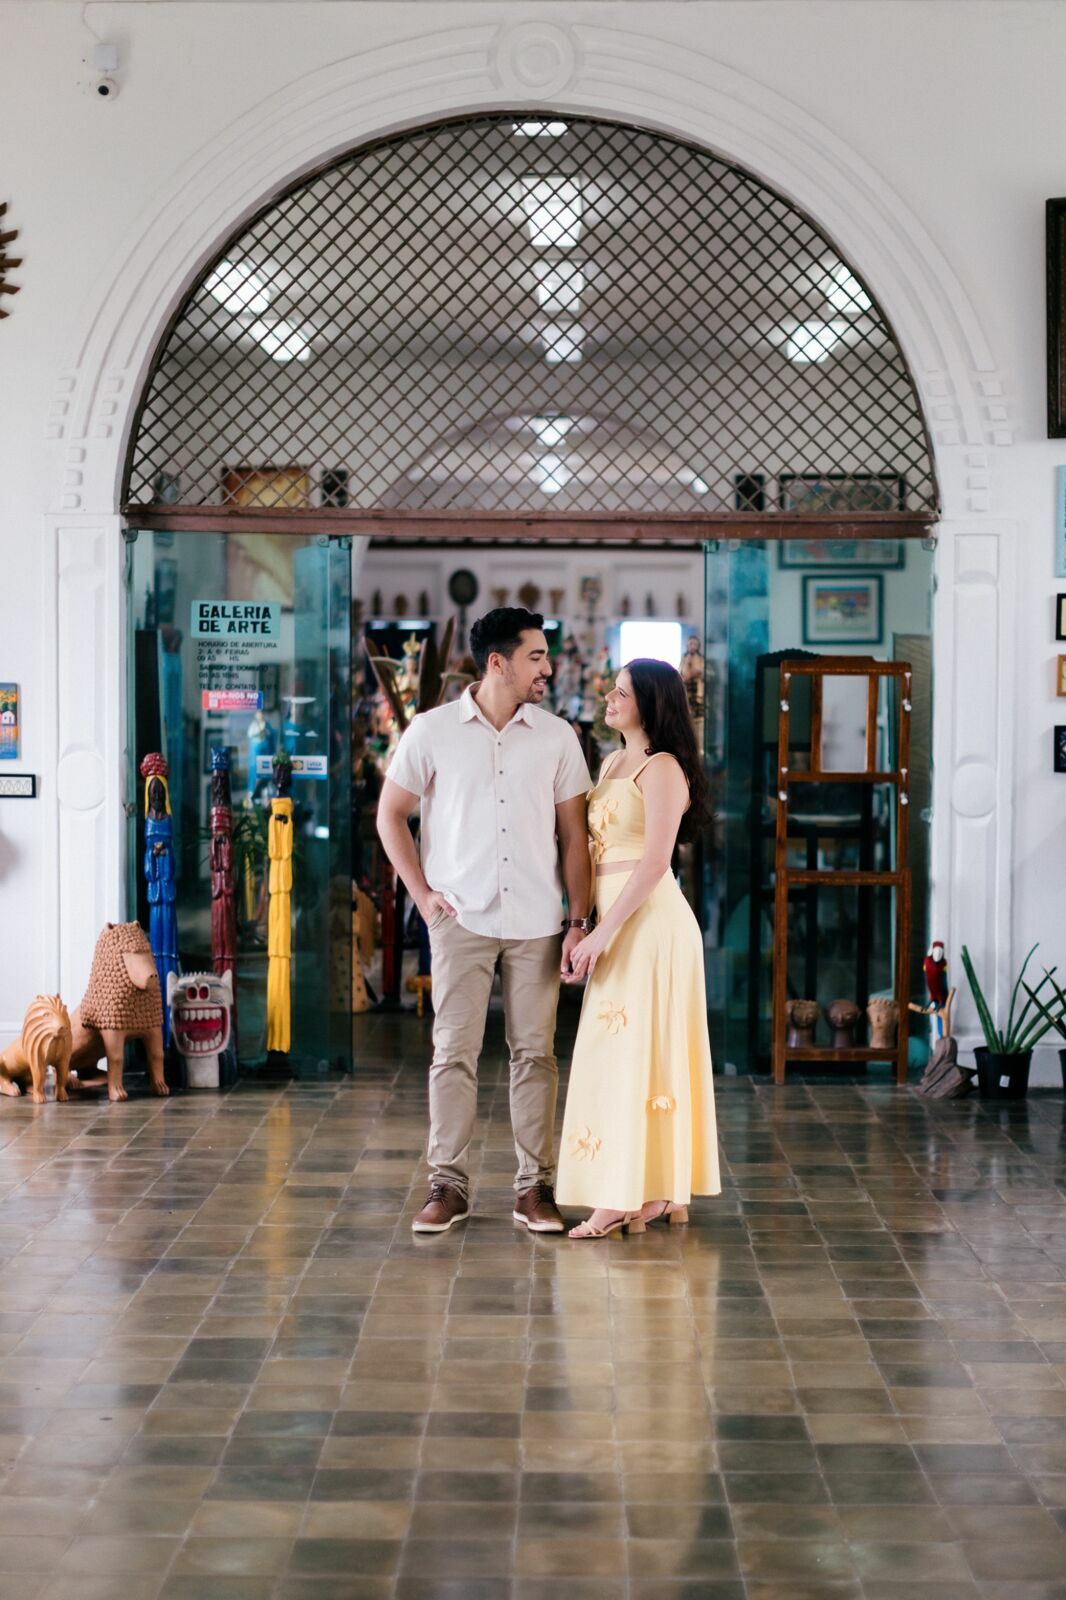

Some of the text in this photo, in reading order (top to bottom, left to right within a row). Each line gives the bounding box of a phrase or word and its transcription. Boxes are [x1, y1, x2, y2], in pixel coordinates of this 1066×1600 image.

[199, 604, 272, 619] GALERIA
[199, 620, 272, 634] DE ARTE
[246, 692, 259, 700] NO
